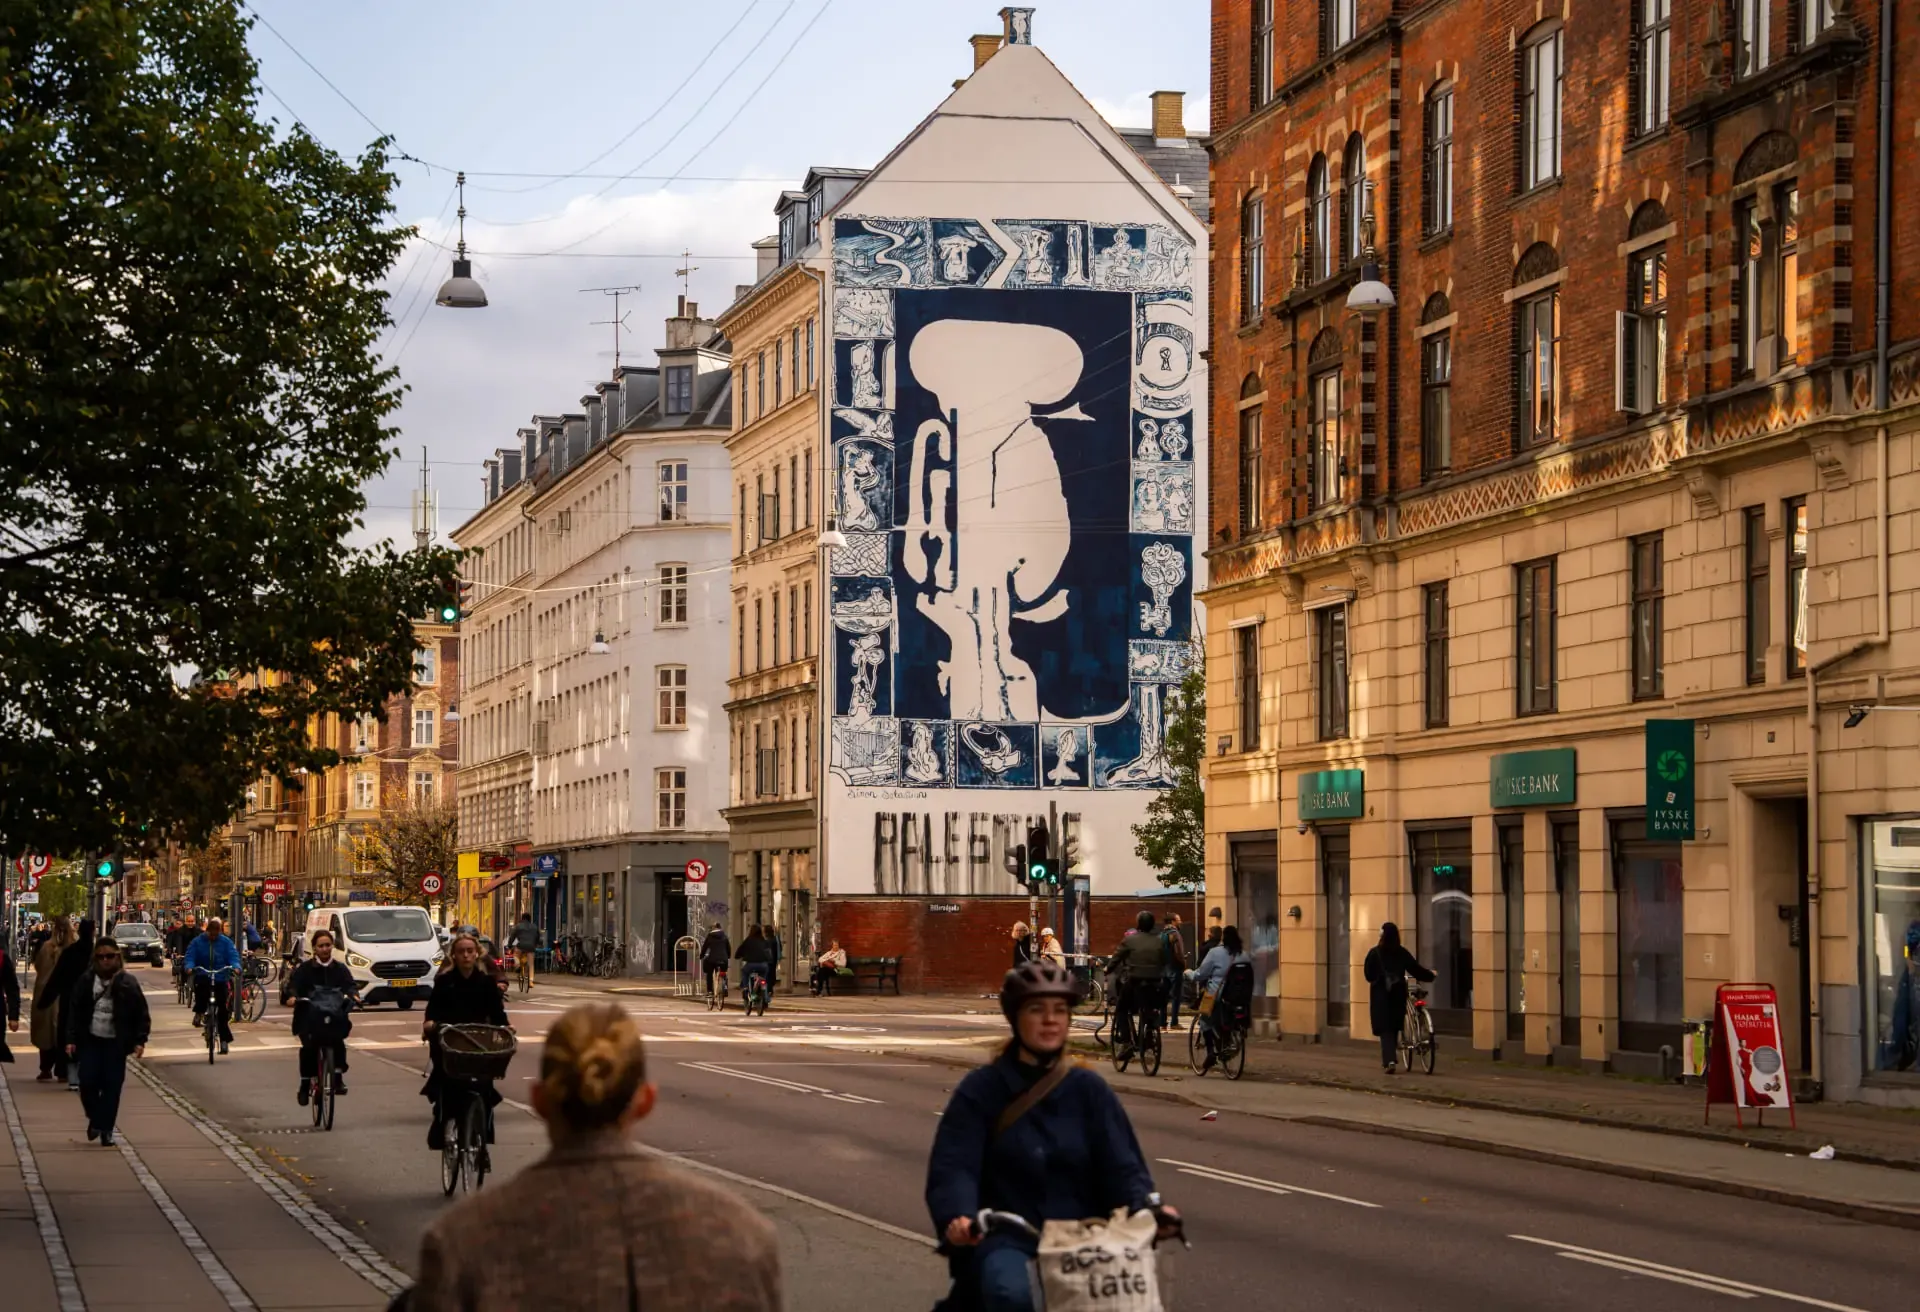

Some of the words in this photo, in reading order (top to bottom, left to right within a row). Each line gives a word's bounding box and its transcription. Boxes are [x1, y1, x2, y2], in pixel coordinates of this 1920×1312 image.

[1505, 776, 1526, 796] YSKE
[1529, 774, 1560, 794] BANK
[1326, 791, 1351, 809] BANK
[1654, 820, 1690, 830] BANK
[874, 812, 1082, 884] PALESTE
[424, 879, 439, 889] 40
[1088, 1268, 1147, 1299] late
